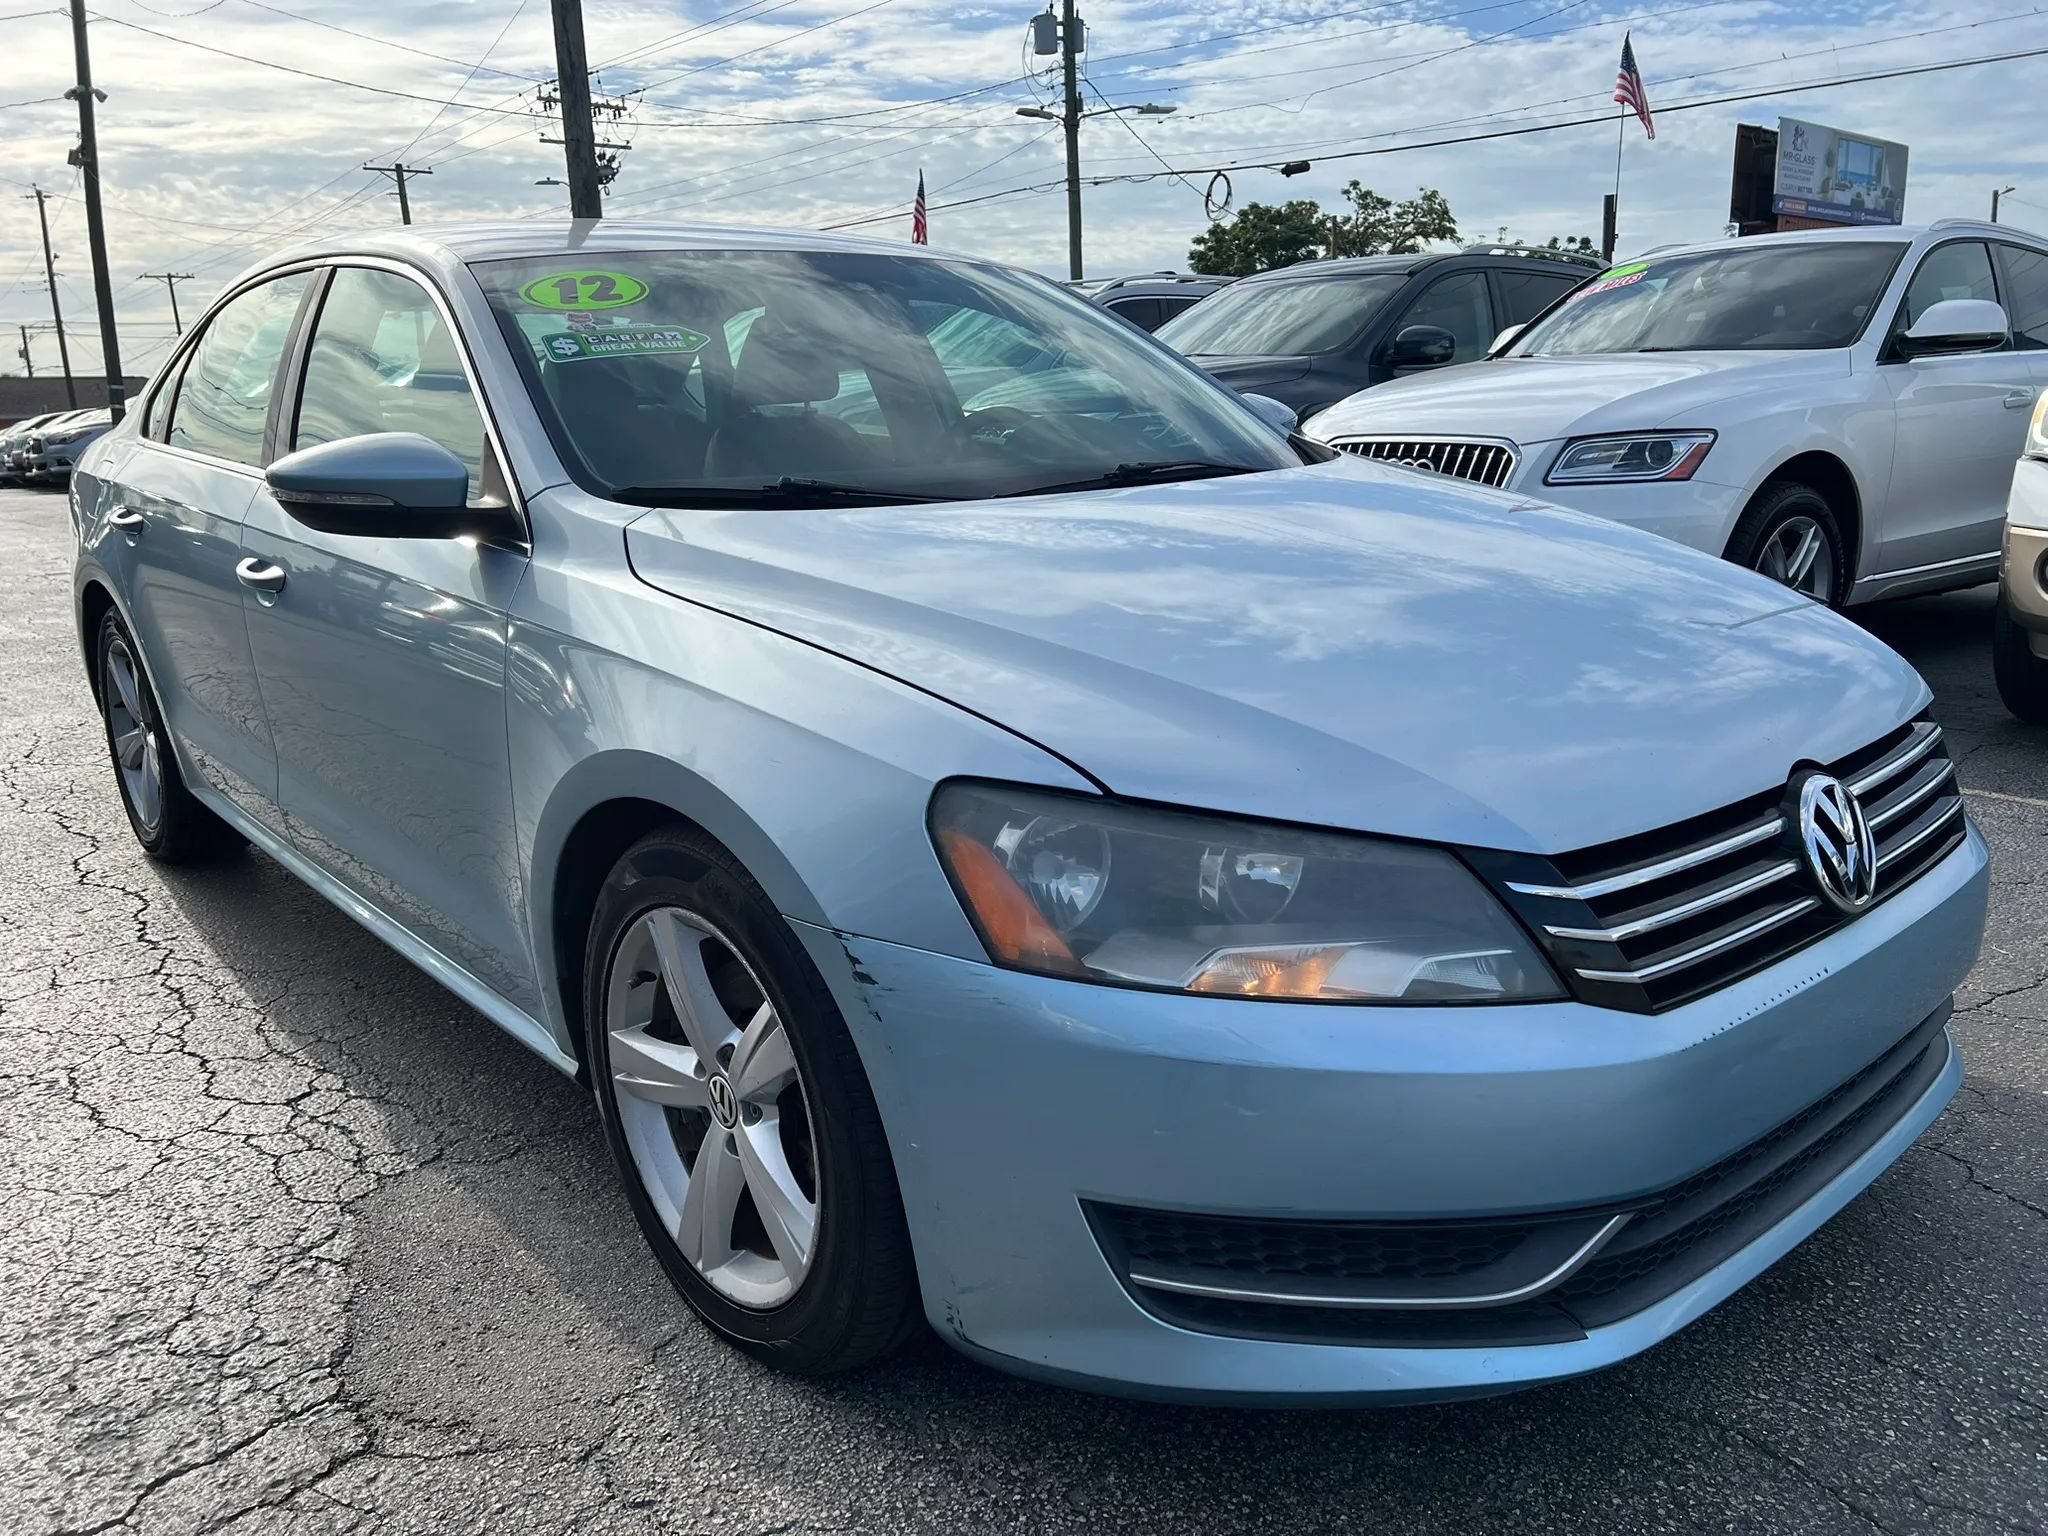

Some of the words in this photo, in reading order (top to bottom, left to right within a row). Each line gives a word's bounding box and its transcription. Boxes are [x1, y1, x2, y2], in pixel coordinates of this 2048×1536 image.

[551, 275, 624, 304] 12
[588, 332, 684, 343] CARFAX
[591, 341, 637, 352] GREAT
[639, 340, 687, 349] VALUE
